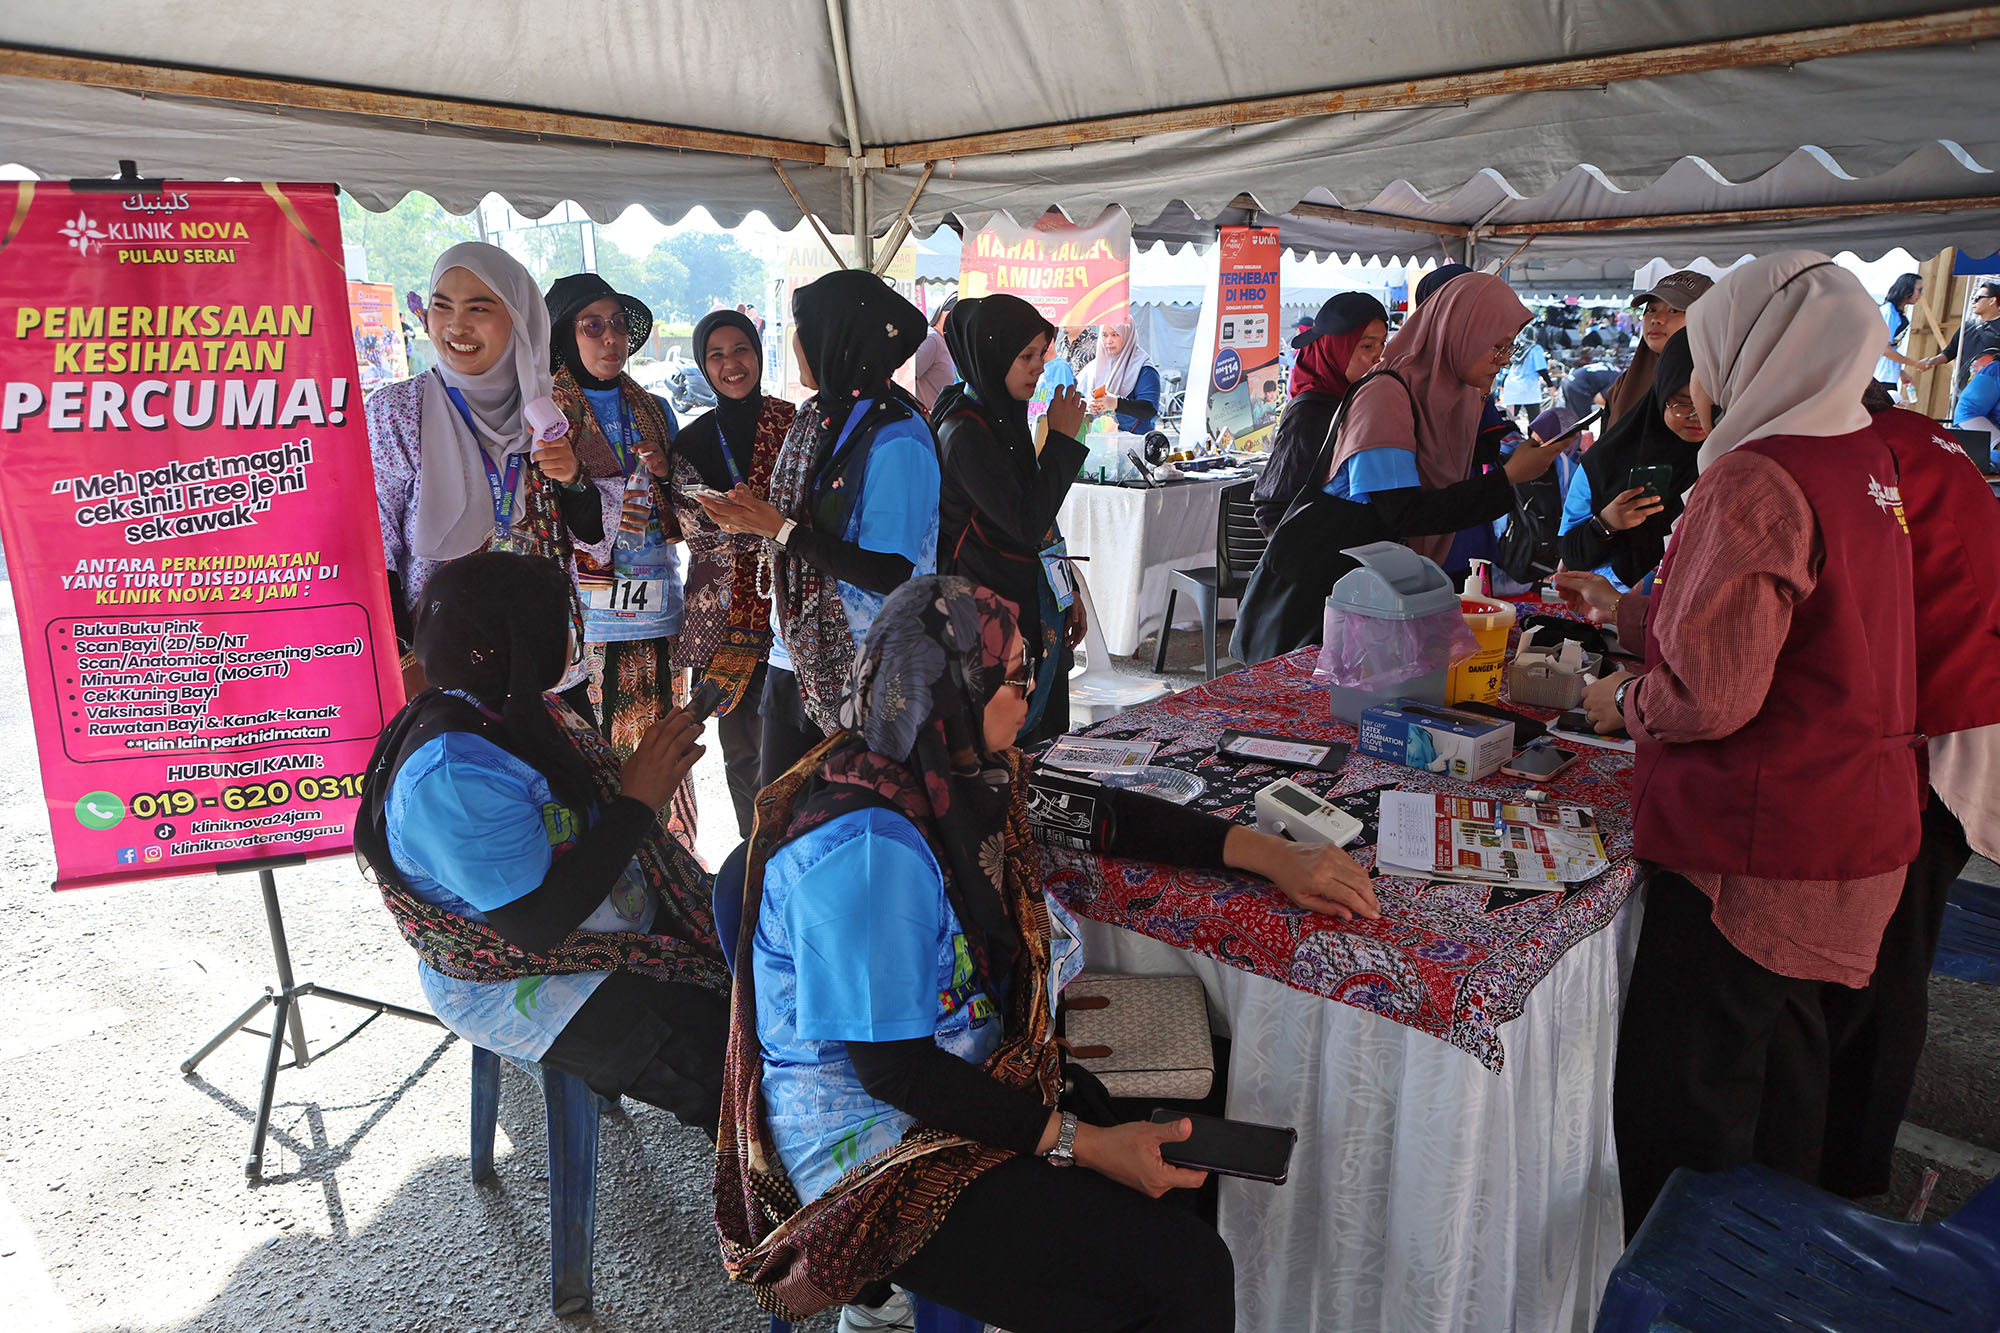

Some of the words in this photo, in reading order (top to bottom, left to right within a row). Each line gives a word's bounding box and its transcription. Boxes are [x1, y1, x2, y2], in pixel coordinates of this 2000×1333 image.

[122, 193, 190, 214] كلينيك
[108, 222, 174, 240] KLINIK
[180, 222, 249, 239] NOVA
[118, 249, 179, 264] PULAU
[183, 249, 236, 263] SERAI
[1220, 272, 1277, 286] TERHEBAT
[1225, 289, 1237, 301] DI
[1240, 288, 1266, 301] HBO
[16, 305, 312, 338] PEMERIKSAAN
[54, 341, 285, 373] KESIHATAN
[1, 377, 351, 432] PERCUMA!
[136, 456, 218, 498] pakat
[221, 437, 313, 475] maghi
[76, 498, 131, 527] cek
[130, 486, 185, 518] sini!
[187, 481, 247, 508] Free
[247, 474, 276, 504] je
[278, 466, 307, 494] ni
[125, 516, 179, 545] sek
[75, 558, 155, 574] ANTARA
[161, 551, 320, 572] PERKHIDMATAN
[61, 574, 117, 590] YANG
[124, 572, 185, 588] TURUT
[191, 567, 312, 587] DISEDIAKAN
[319, 564, 339, 580] DI
[96, 589, 162, 604] KLINIK
[167, 587, 224, 603] NOVA
[229, 585, 252, 601] 24
[255, 583, 298, 603] JAM
[609, 579, 648, 610] 114
[73, 622, 118, 637] Buku
[119, 621, 161, 636] Buku
[164, 619, 203, 635] Pink
[75, 640, 118, 653] Scan
[121, 637, 158, 656] Bayi
[160, 632, 248, 654] (2D/5D/NT
[78, 652, 226, 672] Scan/Anatomical
[227, 645, 312, 664] Screening
[314, 637, 363, 656] Scan)
[80, 672, 141, 687] Minum
[143, 670, 168, 685] Air
[168, 670, 209, 684] Gula
[214, 660, 290, 684] (MOGTT)
[1468, 664, 1493, 673] DANGER
[83, 688, 118, 704] Cek
[118, 687, 179, 704] Kuning
[180, 684, 219, 702] Bayi
[86, 702, 168, 720] Vaksinasi
[169, 700, 208, 718] Bayi
[88, 720, 165, 736] Rawatan
[166, 717, 205, 734] Bayi
[206, 716, 219, 729] &
[222, 705, 341, 728] Kanak-kanak
[177, 735, 208, 750] lain
[210, 726, 331, 752] perkhidmatan
[1361, 731, 1404, 746] EXAMINATION
[1361, 737, 1383, 747] GLOVE
[1362, 725, 1381, 734] LATEX
[167, 761, 259, 783] HUBUNGI
[262, 753, 325, 776] KAMI:
[131, 789, 197, 819] 019
[222, 780, 292, 812] 620
[190, 809, 321, 836] kliniknova24jam
[169, 824, 345, 857] kliniknovaterengganu
